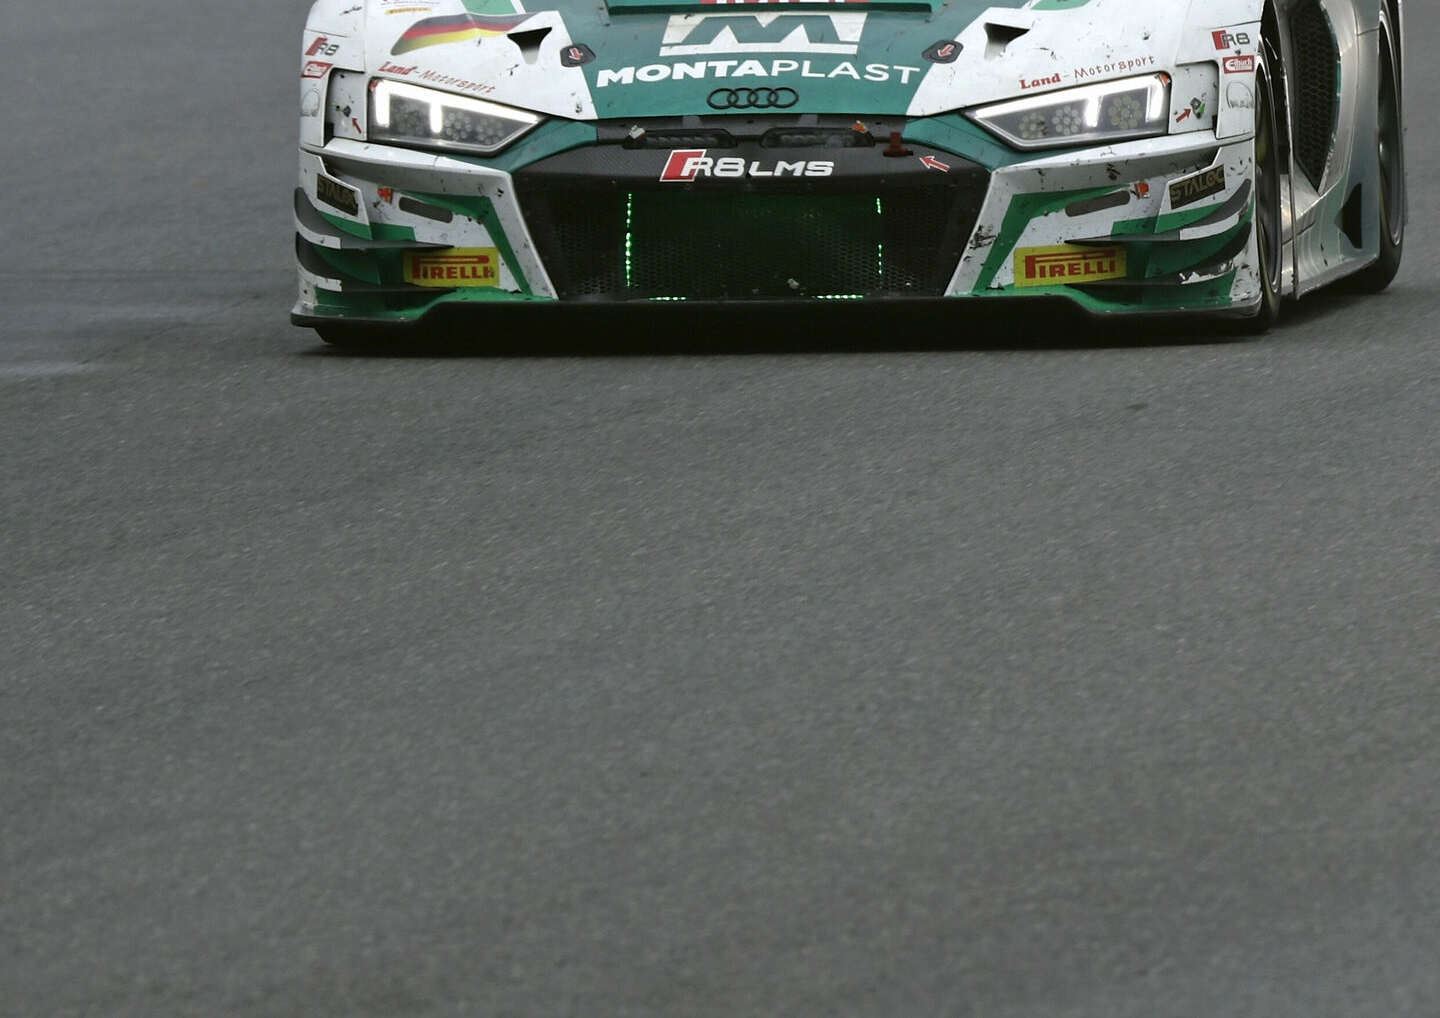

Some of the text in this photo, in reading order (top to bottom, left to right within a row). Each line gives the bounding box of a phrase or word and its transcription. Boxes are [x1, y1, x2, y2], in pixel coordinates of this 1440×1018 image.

[1220, 32, 1251, 47] R8
[596, 59, 921, 88] MONTAPLAST
[680, 157, 835, 178] R8 LMS
[412, 254, 494, 280] PIRELLI
[1025, 247, 1117, 280] PIRELLI
